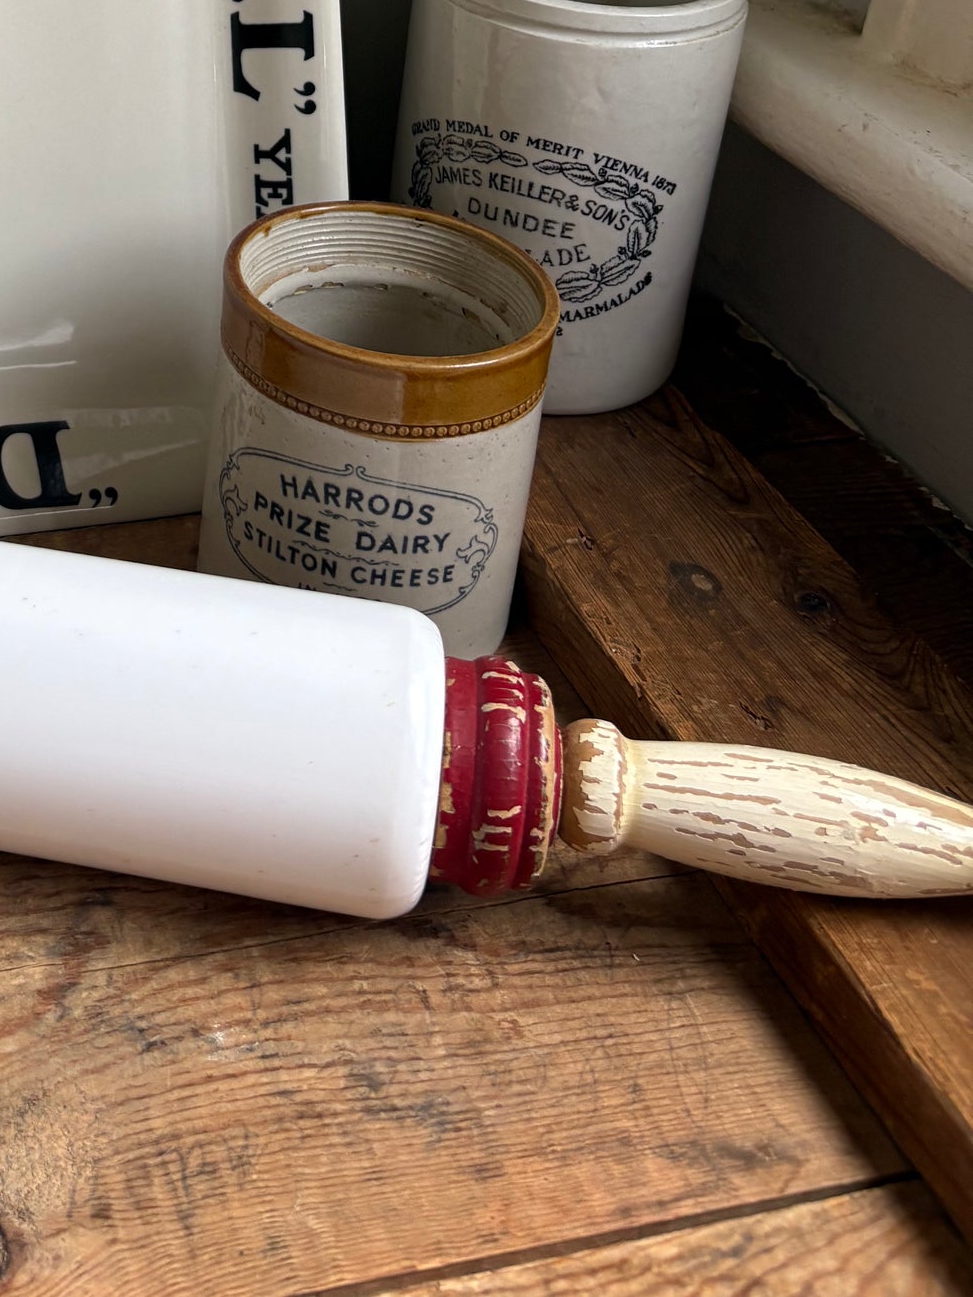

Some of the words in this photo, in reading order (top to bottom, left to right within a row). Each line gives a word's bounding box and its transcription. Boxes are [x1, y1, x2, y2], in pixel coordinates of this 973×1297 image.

[411, 118, 440, 135] GRAND
[446, 119, 493, 138] MEDAL
[499, 129, 520, 143] OF
[526, 135, 584, 159] MERIT
[593, 152, 649, 183] VIENNA
[435, 165, 483, 187] JAMES
[467, 197, 576, 240] DUNDEE
[558, 271, 652, 323] MARMALADE
[253, 490, 331, 543] PRIZE
[355, 530, 451, 554] DAIRY
[279, 473, 435, 526] HARRODS
[243, 520, 338, 579] STILTON
[350, 564, 455, 588] CHEESE
